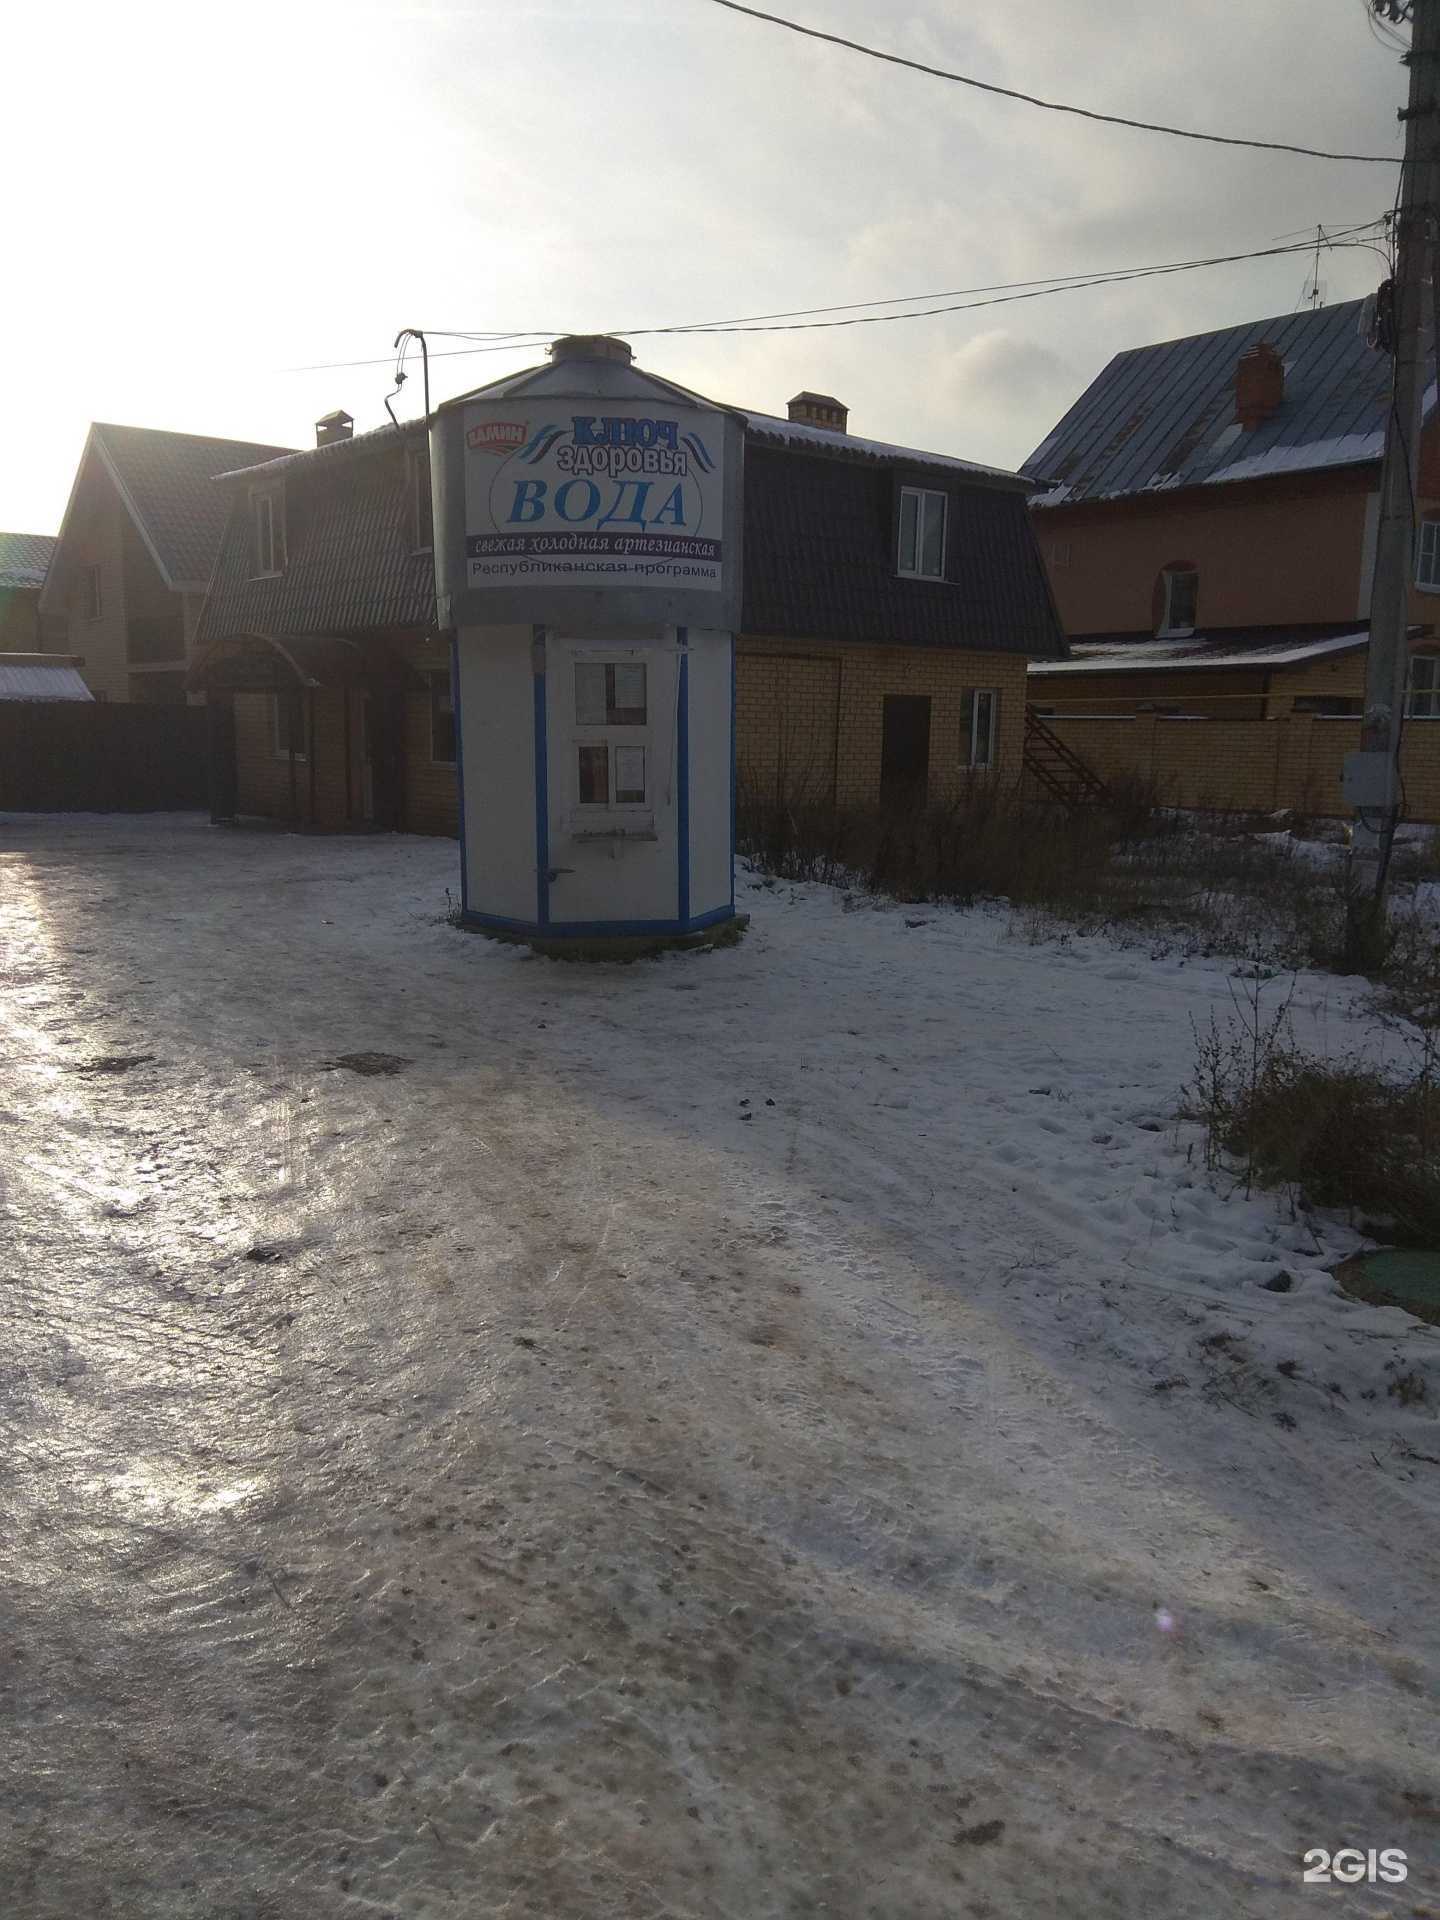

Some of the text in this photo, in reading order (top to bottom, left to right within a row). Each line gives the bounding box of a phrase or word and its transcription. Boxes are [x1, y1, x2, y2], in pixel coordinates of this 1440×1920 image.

[572, 416, 680, 449] КЛЮЧ
[507, 479, 687, 533] ВОДА
[475, 533, 715, 557] свежая холодная артезианская
[472, 560, 717, 579] Республиканская программа
